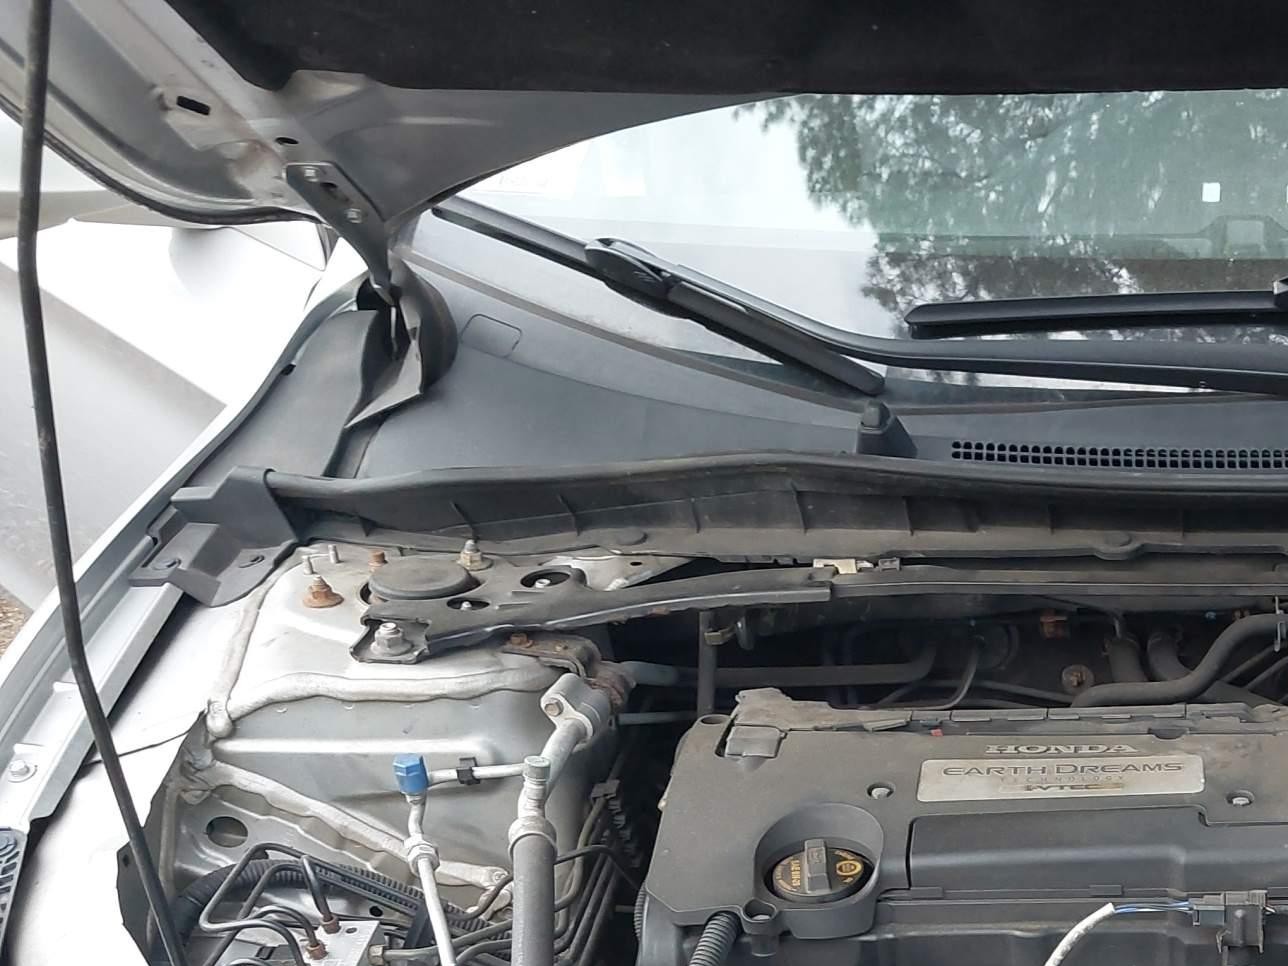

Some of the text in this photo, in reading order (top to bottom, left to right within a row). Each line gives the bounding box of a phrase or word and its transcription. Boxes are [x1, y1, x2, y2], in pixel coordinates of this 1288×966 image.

[985, 744, 1138, 754] HONDA
[943, 762, 1184, 776] EARTH DREAMS
